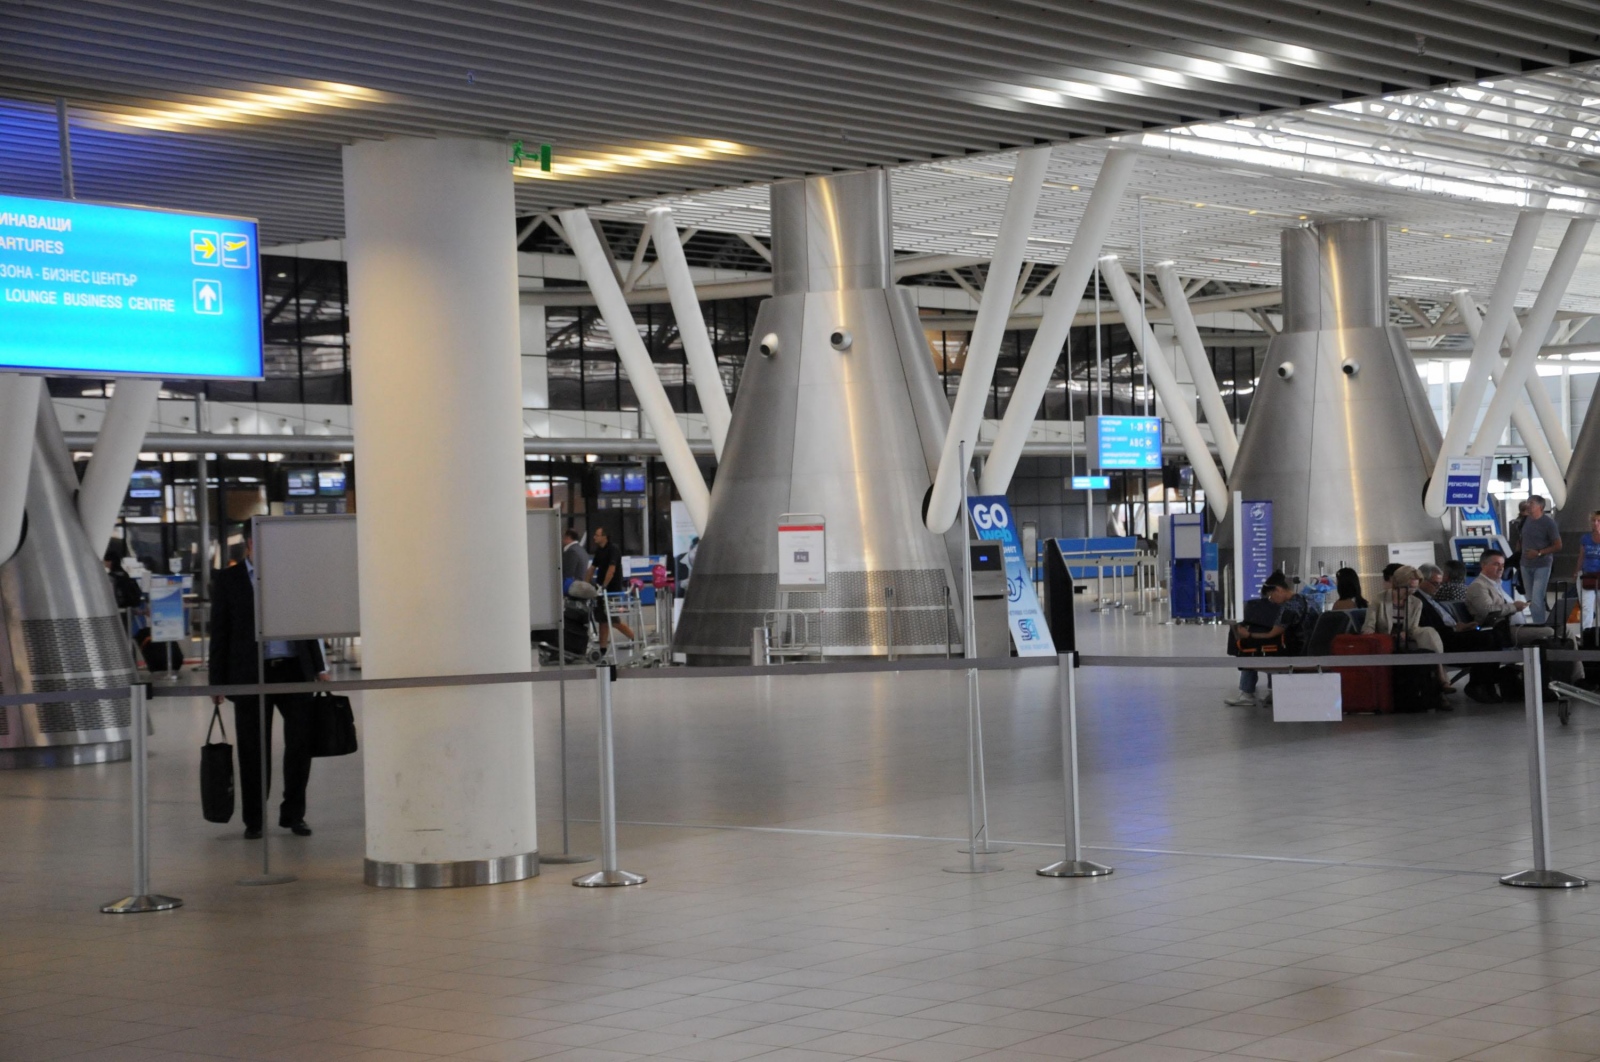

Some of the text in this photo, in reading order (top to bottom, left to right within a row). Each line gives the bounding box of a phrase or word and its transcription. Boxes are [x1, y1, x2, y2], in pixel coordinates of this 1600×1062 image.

[42, 267, 90, 284] БИЗНЕС
[92, 270, 137, 287] ЦЕНТЪР
[5, 288, 175, 312] LOUNGE BUSINESS CENTRE
[973, 503, 1008, 530] GO
